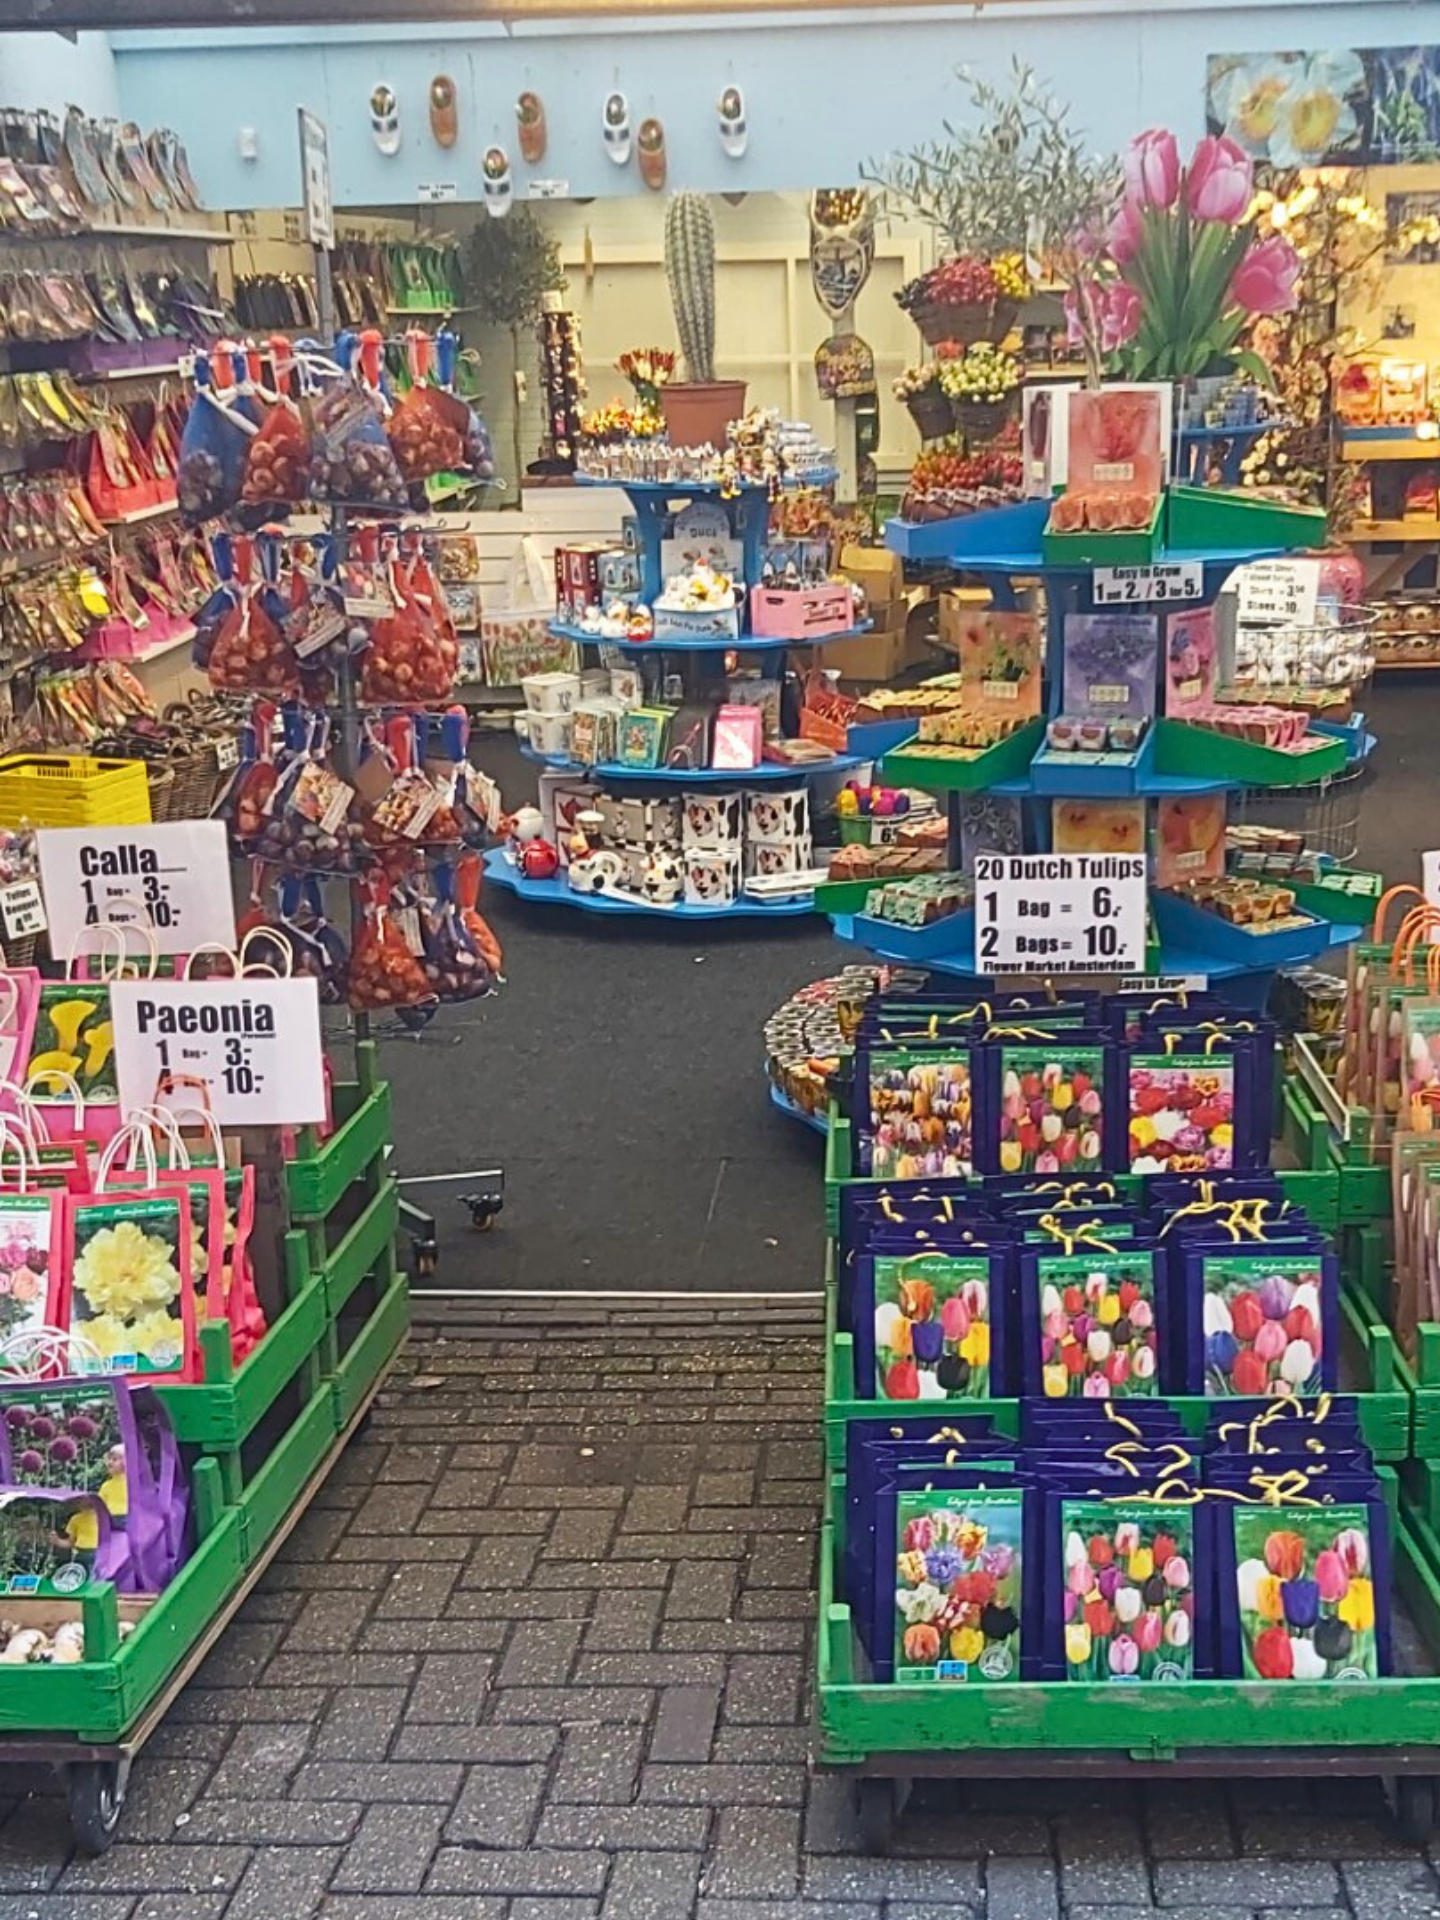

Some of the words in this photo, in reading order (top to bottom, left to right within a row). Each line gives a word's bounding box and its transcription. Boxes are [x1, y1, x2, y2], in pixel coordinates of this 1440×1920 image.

[1112, 567, 1138, 579] Easy
[1153, 566, 1182, 577] Grow
[1096, 583, 1104, 601] 1
[1156, 580, 1167, 598] 3
[80, 844, 159, 876] Calla
[977, 858, 1004, 880] 20
[1010, 858, 1072, 880] Dutch
[1078, 857, 1144, 880] Tulips
[80, 879, 93, 904] 1
[85, 904, 99, 925] 4
[984, 892, 997, 922] 1
[1018, 900, 1050, 918] Bag
[980, 926, 999, 957] 2
[1016, 936, 1058, 955] Bags
[983, 961, 1022, 972] Flower
[1025, 961, 1067, 971] Market
[1069, 960, 1136, 971] Amsterdam
[137, 999, 275, 1033] Paeonia
[156, 1039, 169, 1066] 1
